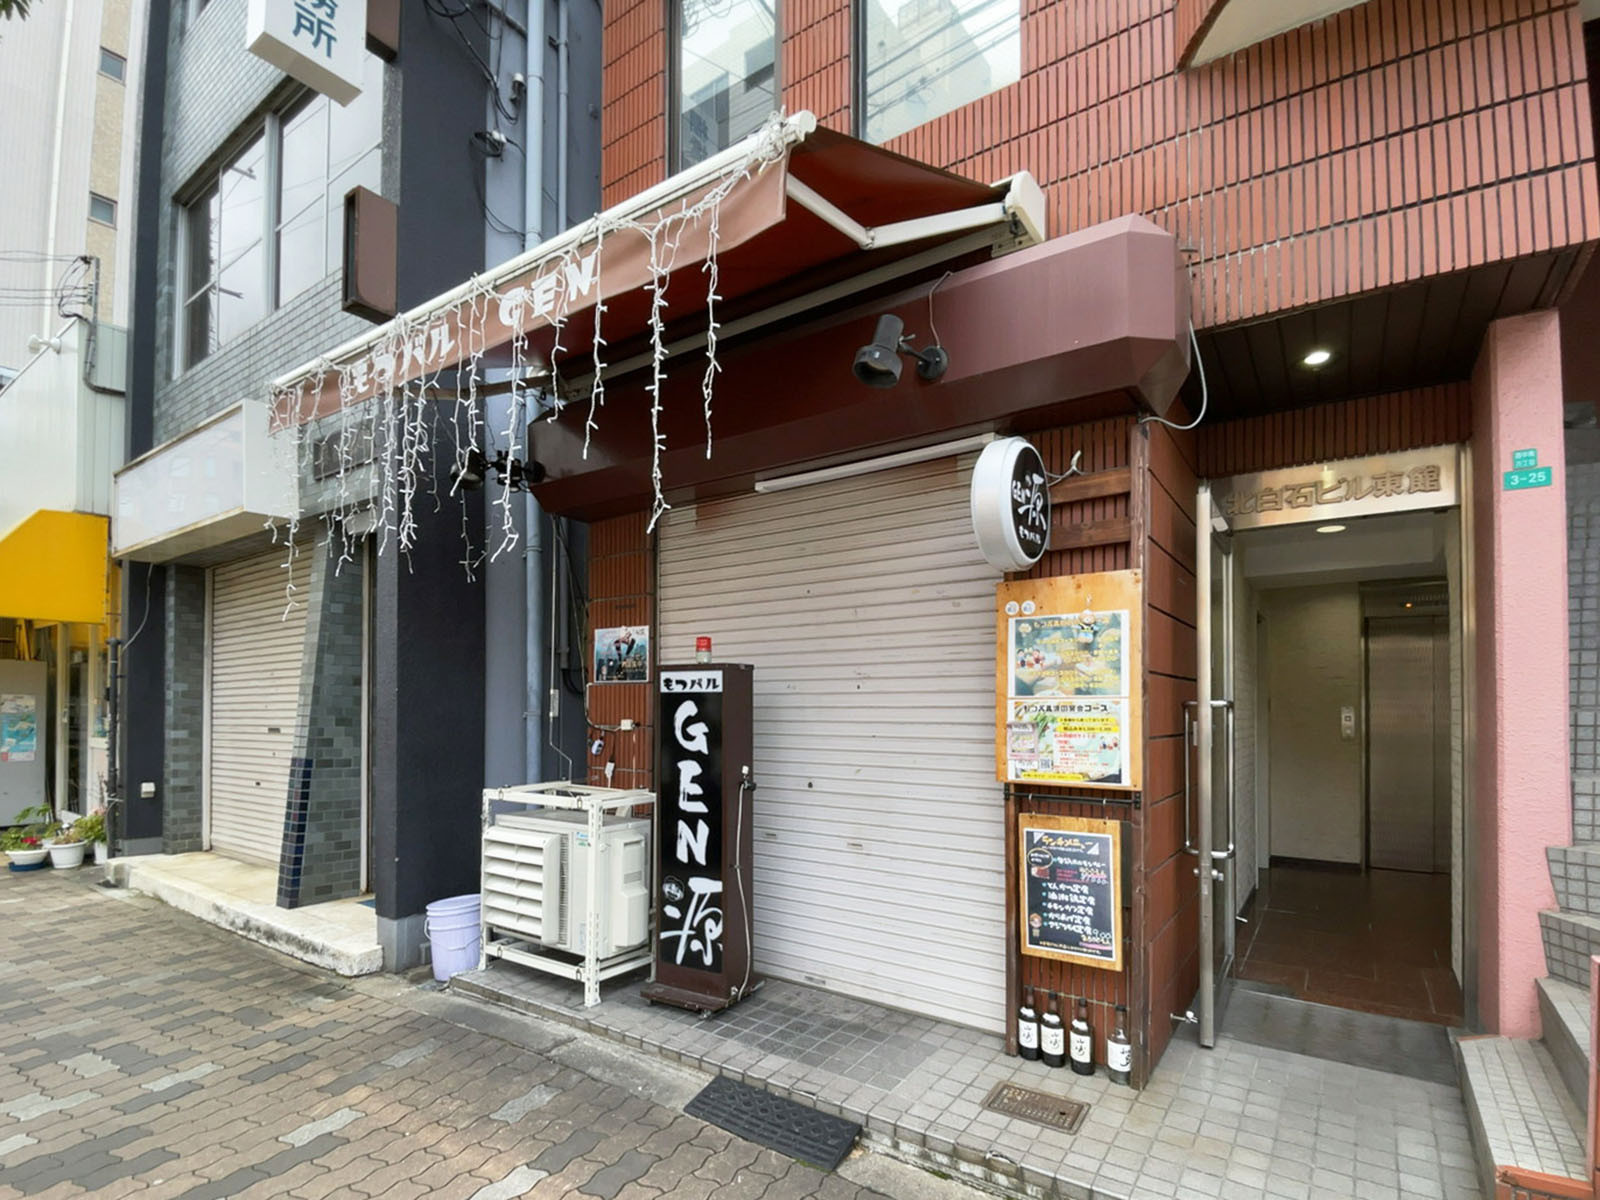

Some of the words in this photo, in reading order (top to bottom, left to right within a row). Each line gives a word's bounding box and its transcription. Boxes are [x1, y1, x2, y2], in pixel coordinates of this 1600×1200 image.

[500, 252, 598, 327] GEN
[1226, 464, 1441, 517] 北白石ビル東館
[1510, 471, 1546, 486] 3-25
[663, 677, 720, 691] もつバル
[674, 699, 710, 867] GEN
